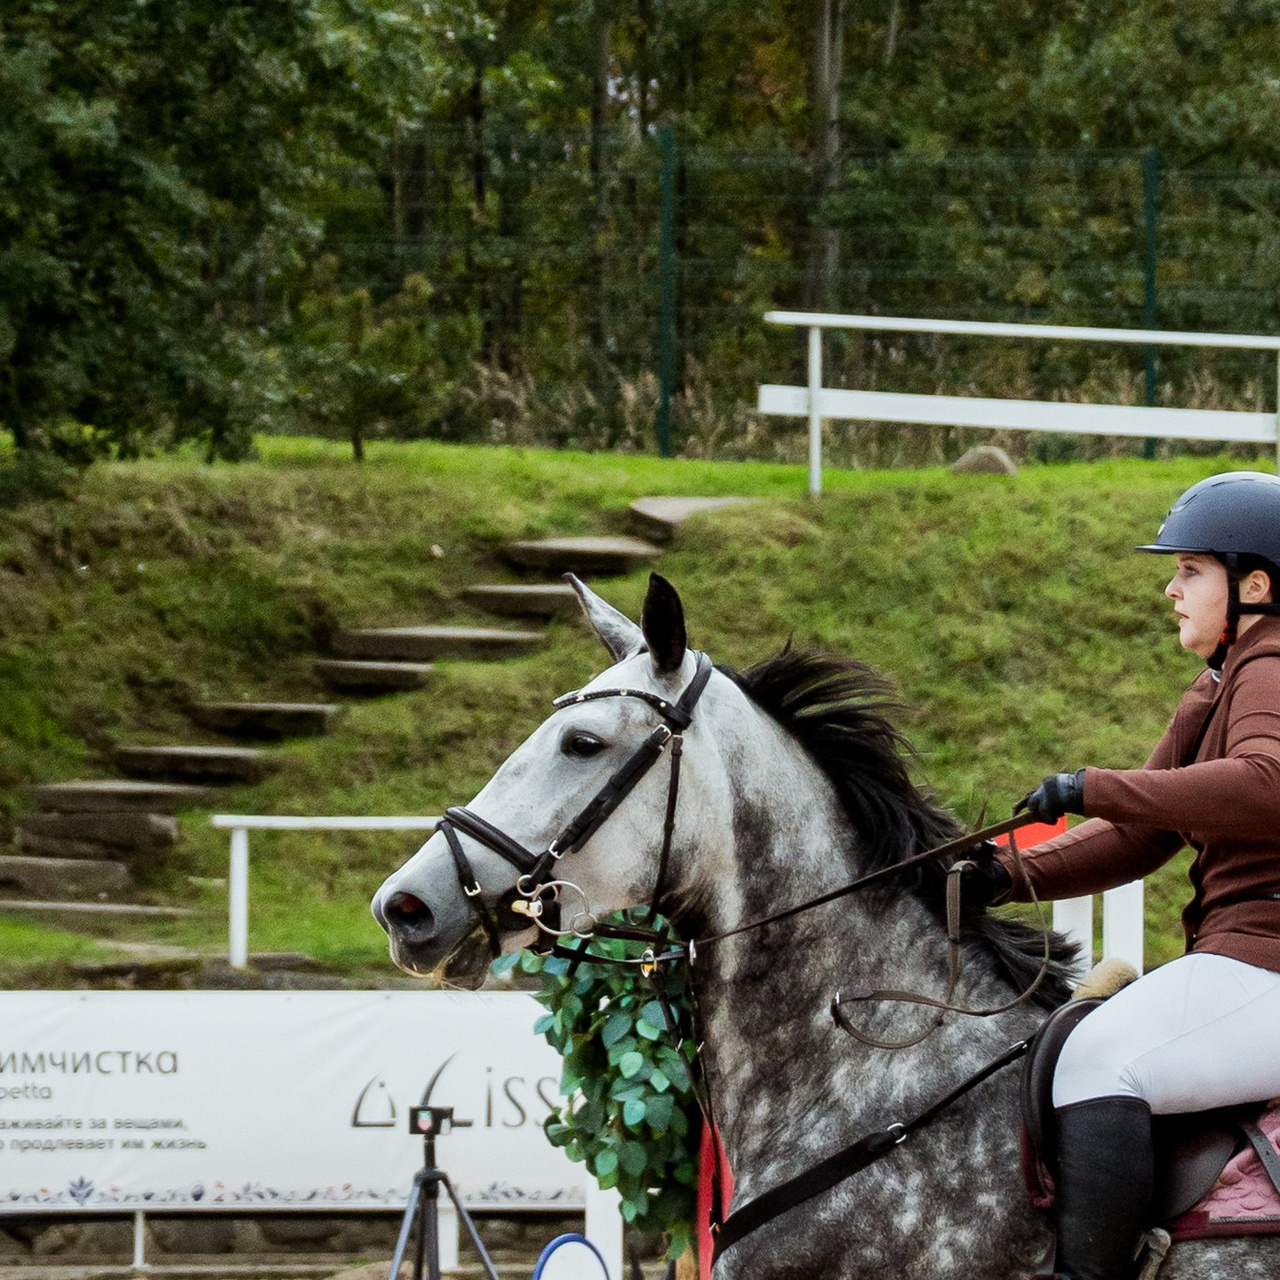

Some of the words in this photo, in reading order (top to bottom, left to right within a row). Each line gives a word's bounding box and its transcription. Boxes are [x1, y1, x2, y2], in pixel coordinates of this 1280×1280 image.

[90, 1119, 107, 1130] за
[114, 1119, 188, 1132] вещами,
[10, 1138, 115, 1152] продлевает
[121, 1138, 144, 1150] им
[151, 1138, 207, 1150] жизнь
